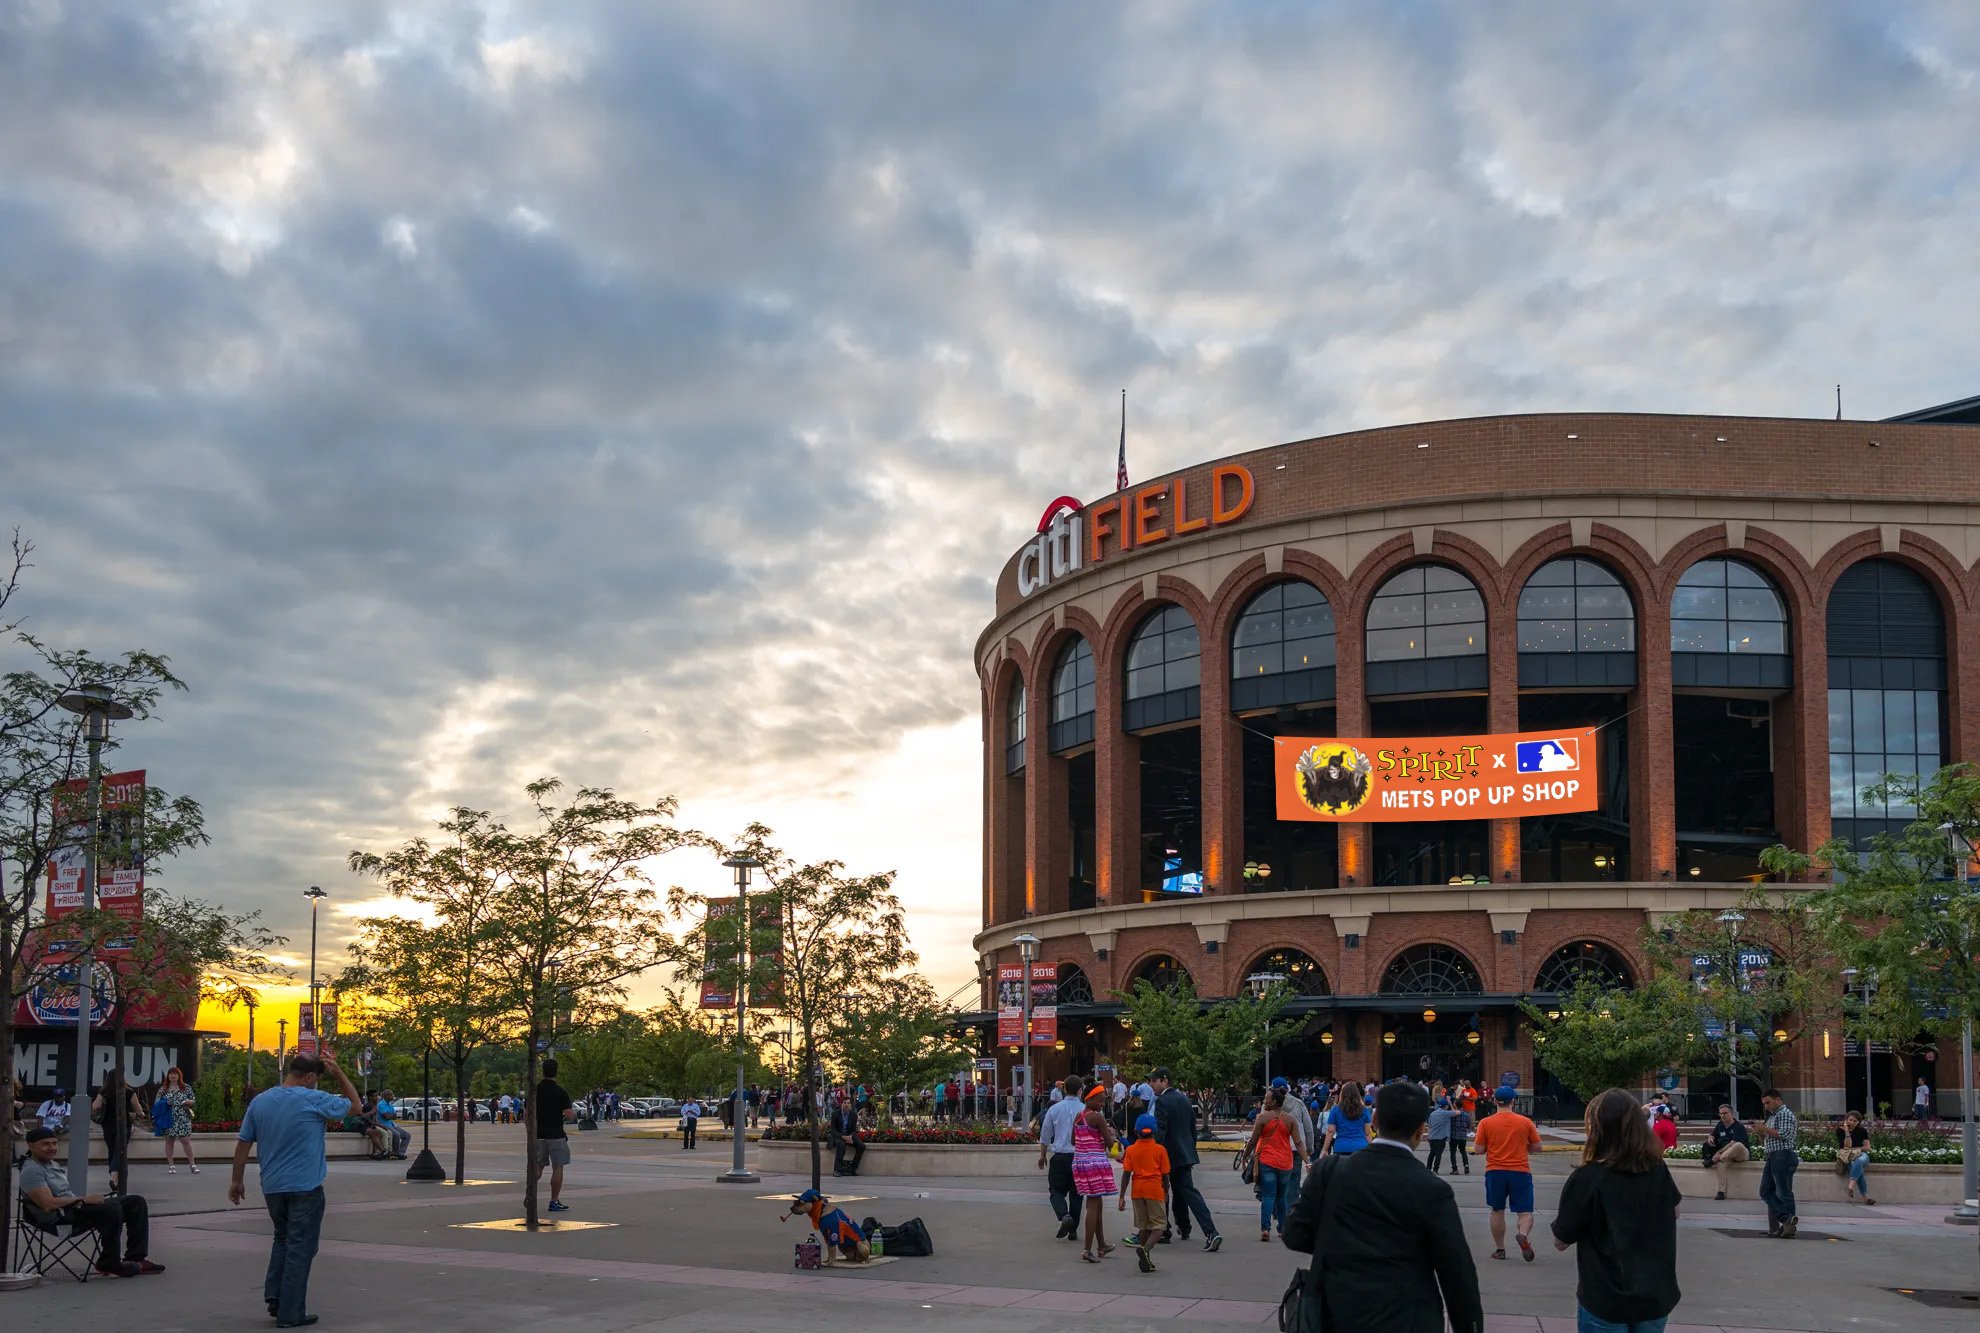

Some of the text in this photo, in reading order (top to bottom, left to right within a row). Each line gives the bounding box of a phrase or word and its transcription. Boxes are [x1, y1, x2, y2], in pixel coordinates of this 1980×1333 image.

[1017, 463, 1255, 598] citi FIELD
[1377, 744, 1483, 781] SPIRIT
[1381, 779, 1580, 809] METS POP UP SHOP
[62, 868, 79, 877] FREE
[115, 872, 138, 881] FAMILY
[54, 882, 75, 891] SHIRT
[104, 886, 134, 896] SUNDAYS
[1001, 969, 1022, 978] 2016
[1033, 968, 1054, 977] 2016
[41, 986, 98, 1009] Mes
[91, 1044, 178, 1088] RUN
